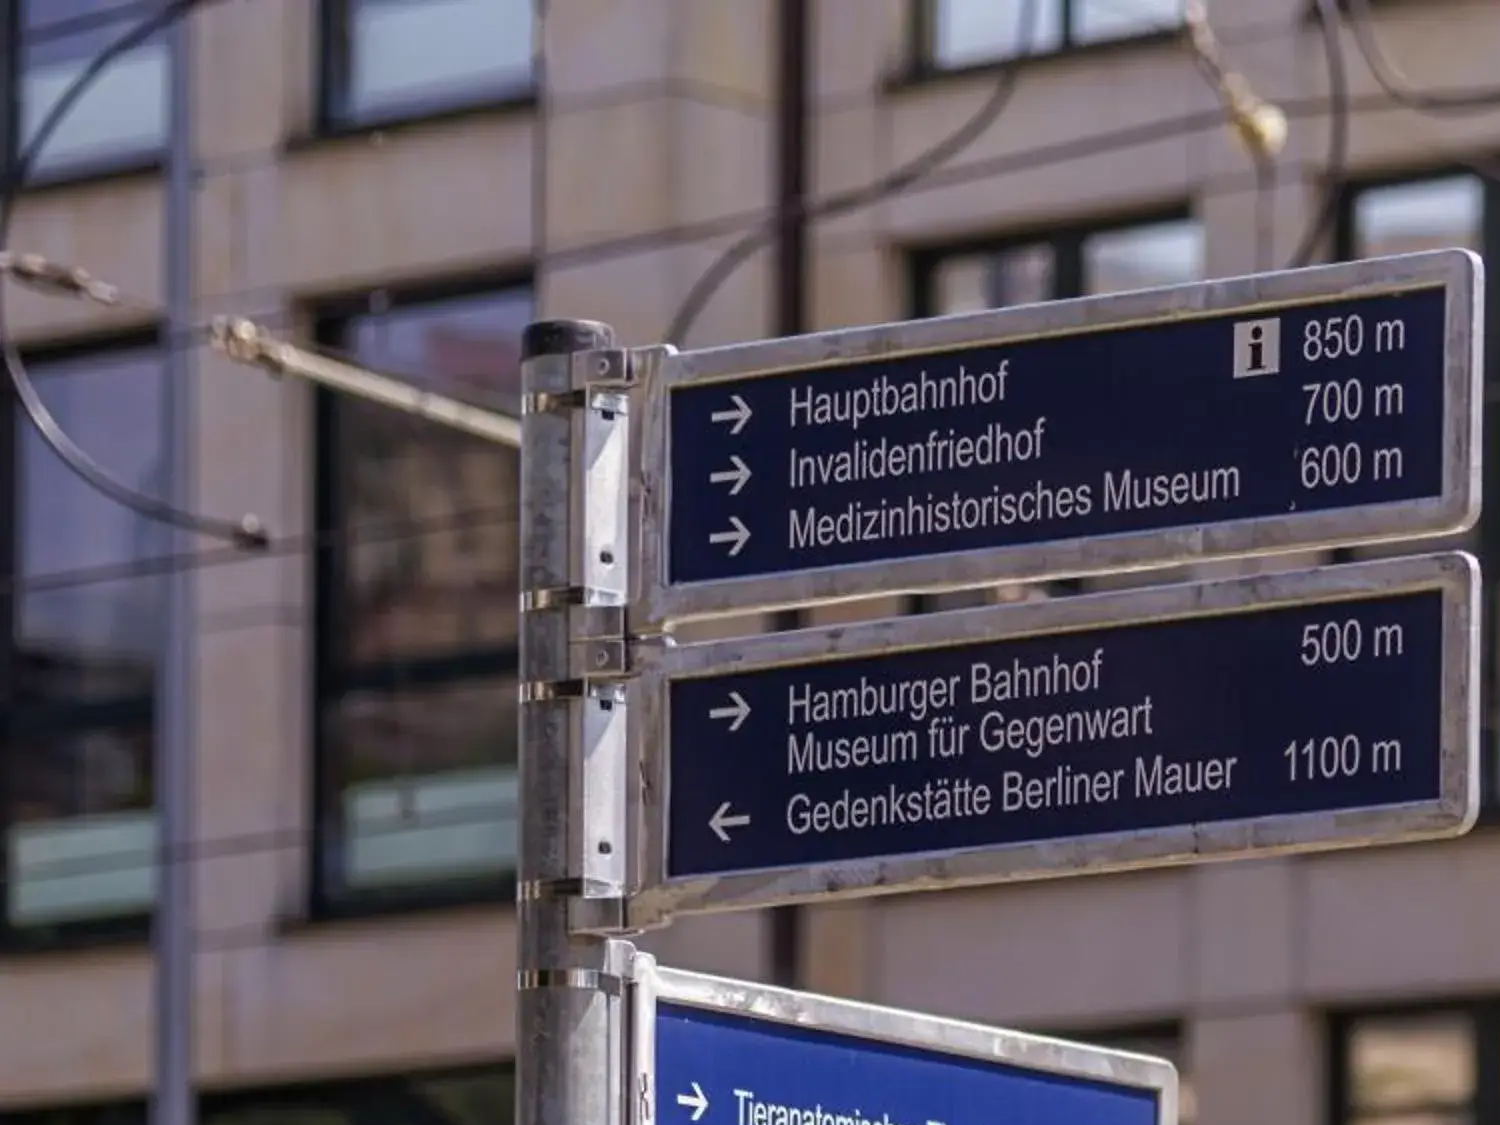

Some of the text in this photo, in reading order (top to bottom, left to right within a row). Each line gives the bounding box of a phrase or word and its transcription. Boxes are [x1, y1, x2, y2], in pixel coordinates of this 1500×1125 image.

[790, 359, 1009, 429] Hauptbahnhof
[1303, 314, 1363, 361] 850
[1376, 319, 1405, 353] m
[790, 378, 1403, 488] Invalidenfriedhof 700 m
[789, 442, 1402, 549] Medizinhistorisches Museum 600 m
[789, 619, 1403, 725] Hamburger Bahnhof 500 m
[787, 734, 1401, 834] Gedenkstätte Berliner Mauer 1100 m
[788, 696, 1153, 773] Museum für Gegenwart
